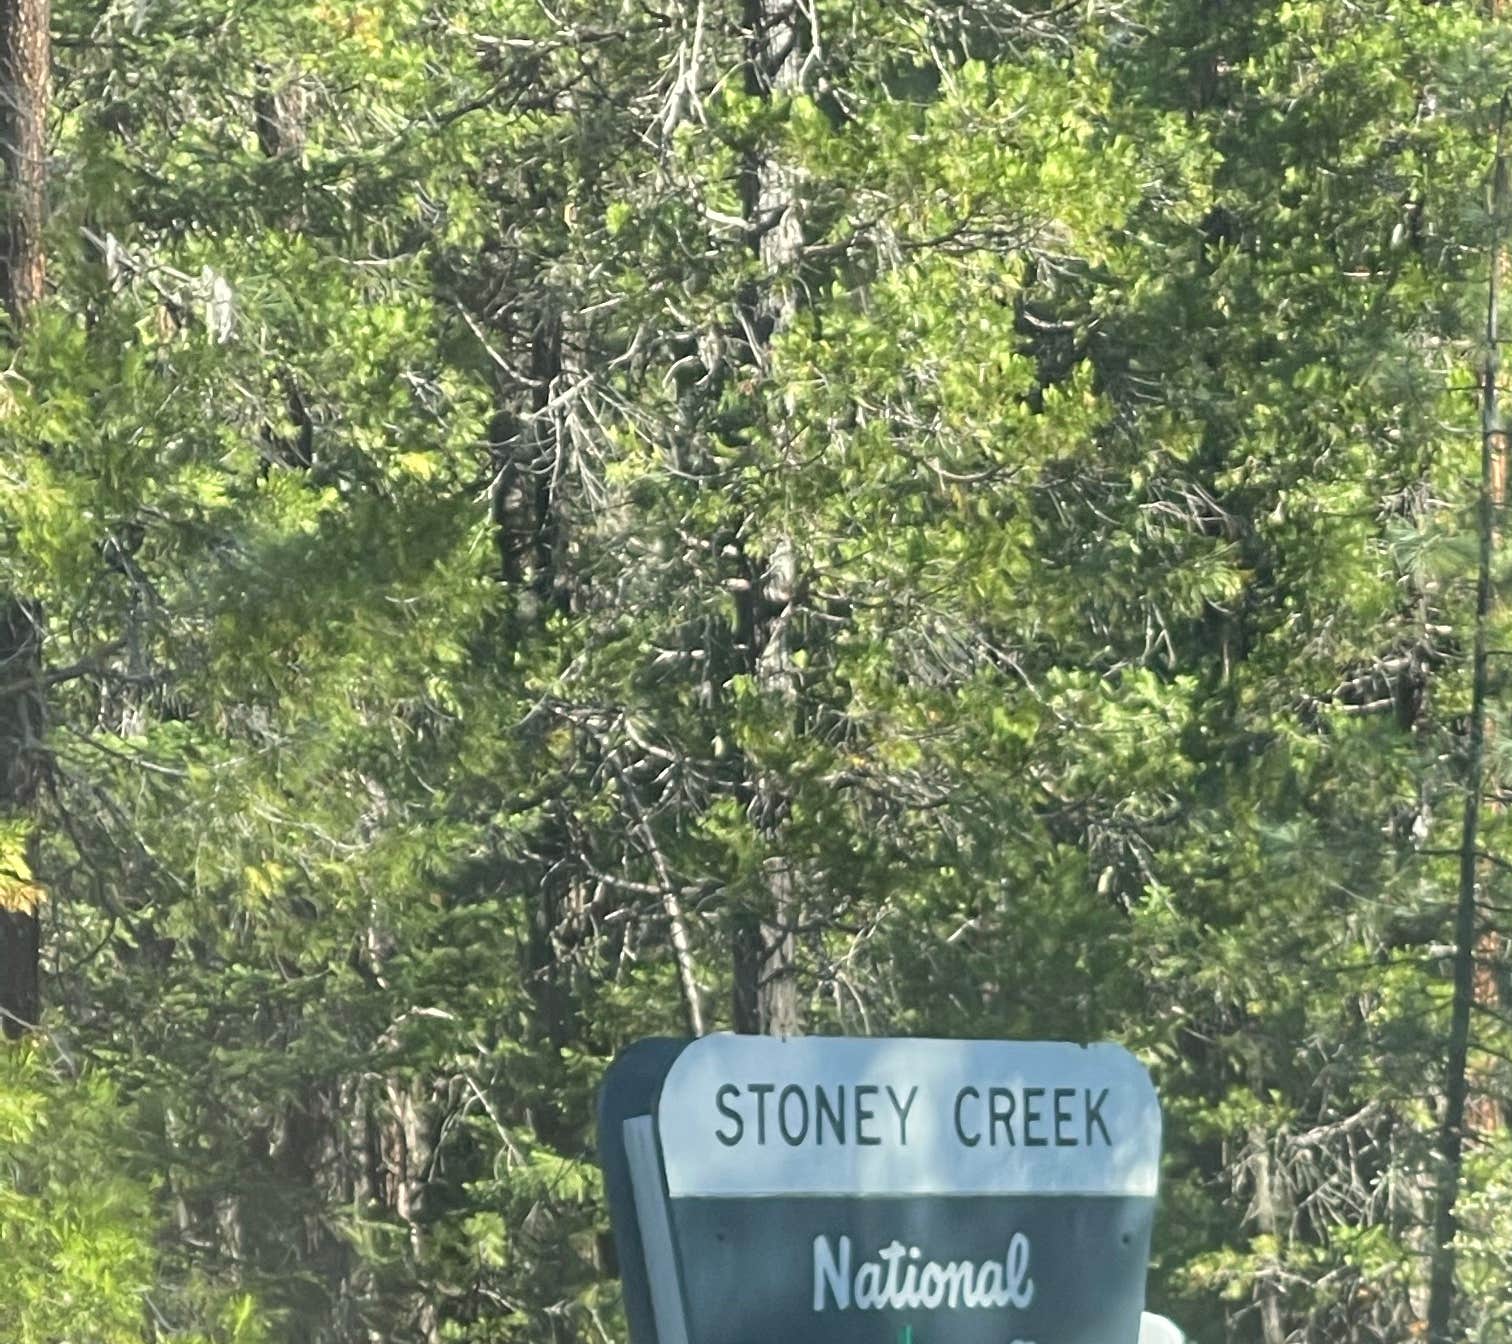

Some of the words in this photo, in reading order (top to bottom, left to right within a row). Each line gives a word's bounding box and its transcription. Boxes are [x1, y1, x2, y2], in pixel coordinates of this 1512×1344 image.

[714, 1082, 919, 1147] STONEY
[953, 1085, 1113, 1147] CREEK
[813, 1232, 1034, 1311] National
